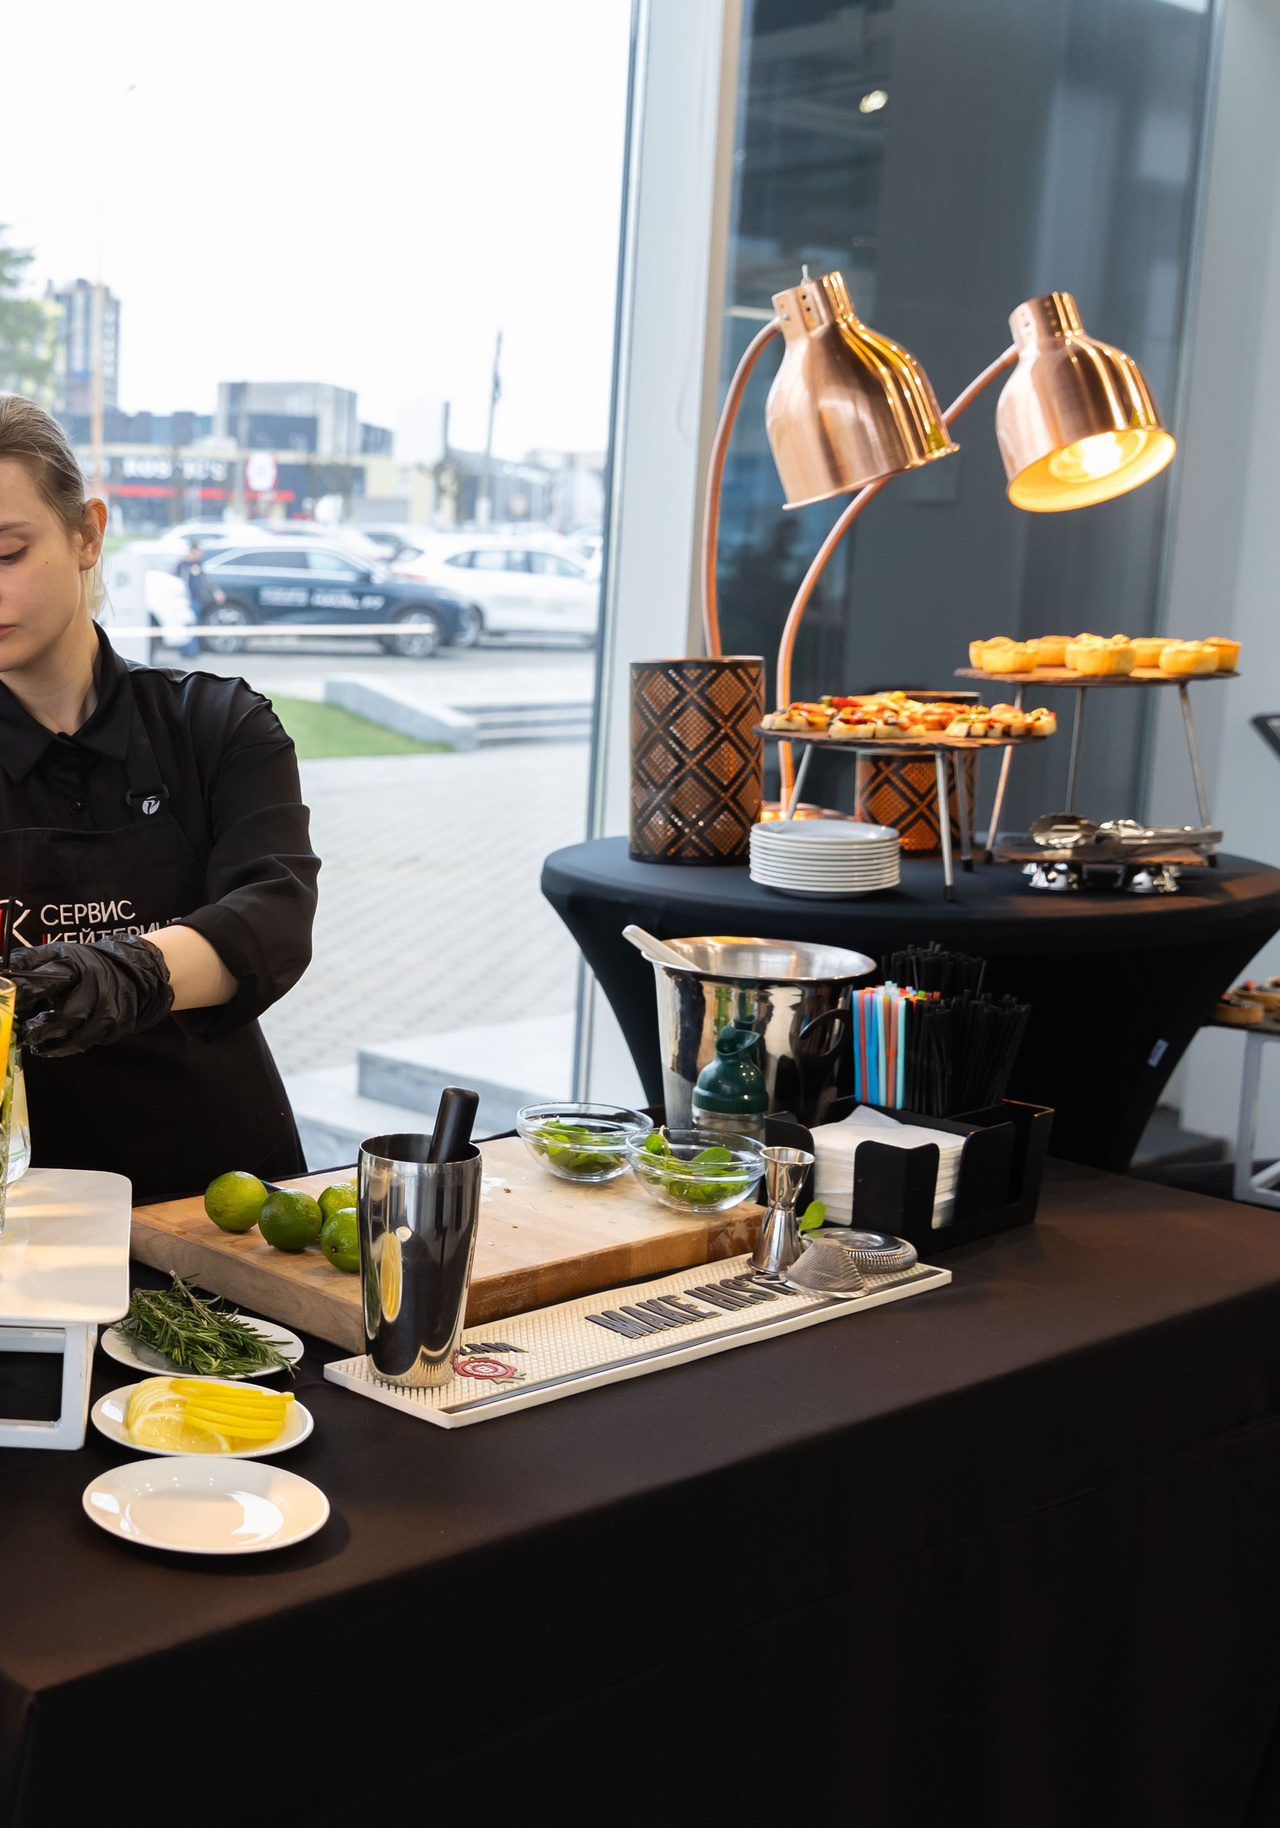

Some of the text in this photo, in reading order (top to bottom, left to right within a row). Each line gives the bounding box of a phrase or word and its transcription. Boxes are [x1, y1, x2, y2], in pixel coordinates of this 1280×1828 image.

[40, 900, 136, 926] СЕРВИС
[42, 916, 182, 945] КЕЙТРИ
[585, 1271, 798, 1340] MAKE HIST
